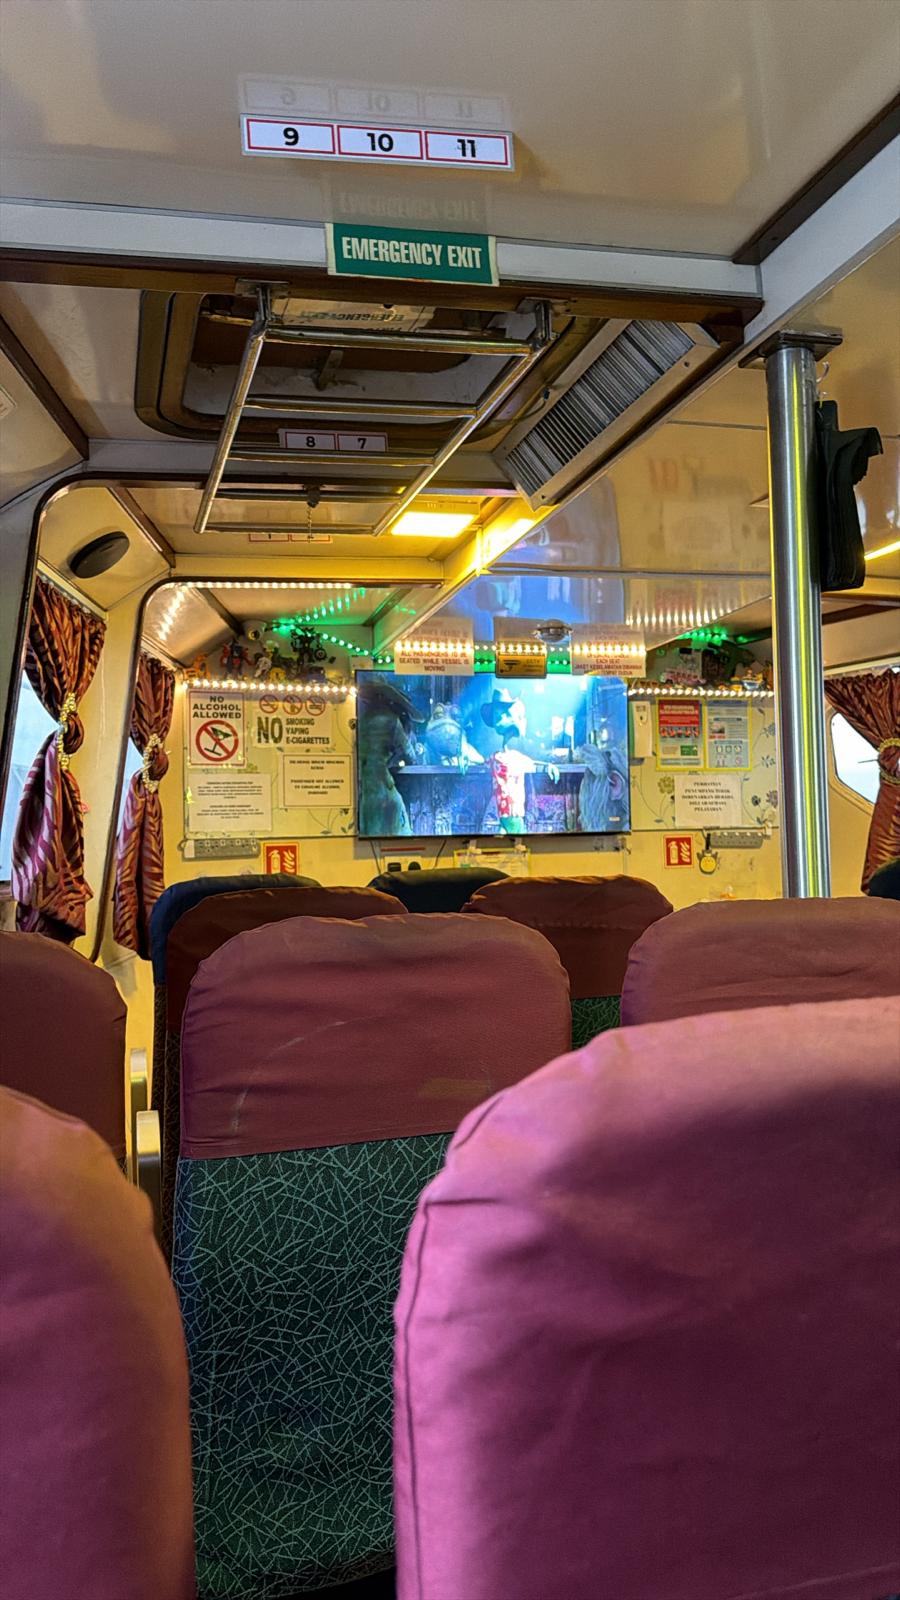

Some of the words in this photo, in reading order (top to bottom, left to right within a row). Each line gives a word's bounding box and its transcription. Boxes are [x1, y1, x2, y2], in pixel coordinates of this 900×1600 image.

[283, 127, 300, 146] 9
[367, 132, 394, 152] 10
[457, 138, 476, 158] 11
[341, 236, 442, 266] EMERGENCY
[448, 244, 482, 269] EXIT
[306, 436, 316, 448] 8
[357, 437, 367, 449] 7
[193, 703, 241, 711] ALCOHOL
[193, 711, 242, 719] ALLOWED
[286, 717, 315, 726] SMOKING
[257, 716, 284, 744] NO
[286, 727, 309, 735] VAPING
[286, 736, 330, 745] E-CIGARETTES
